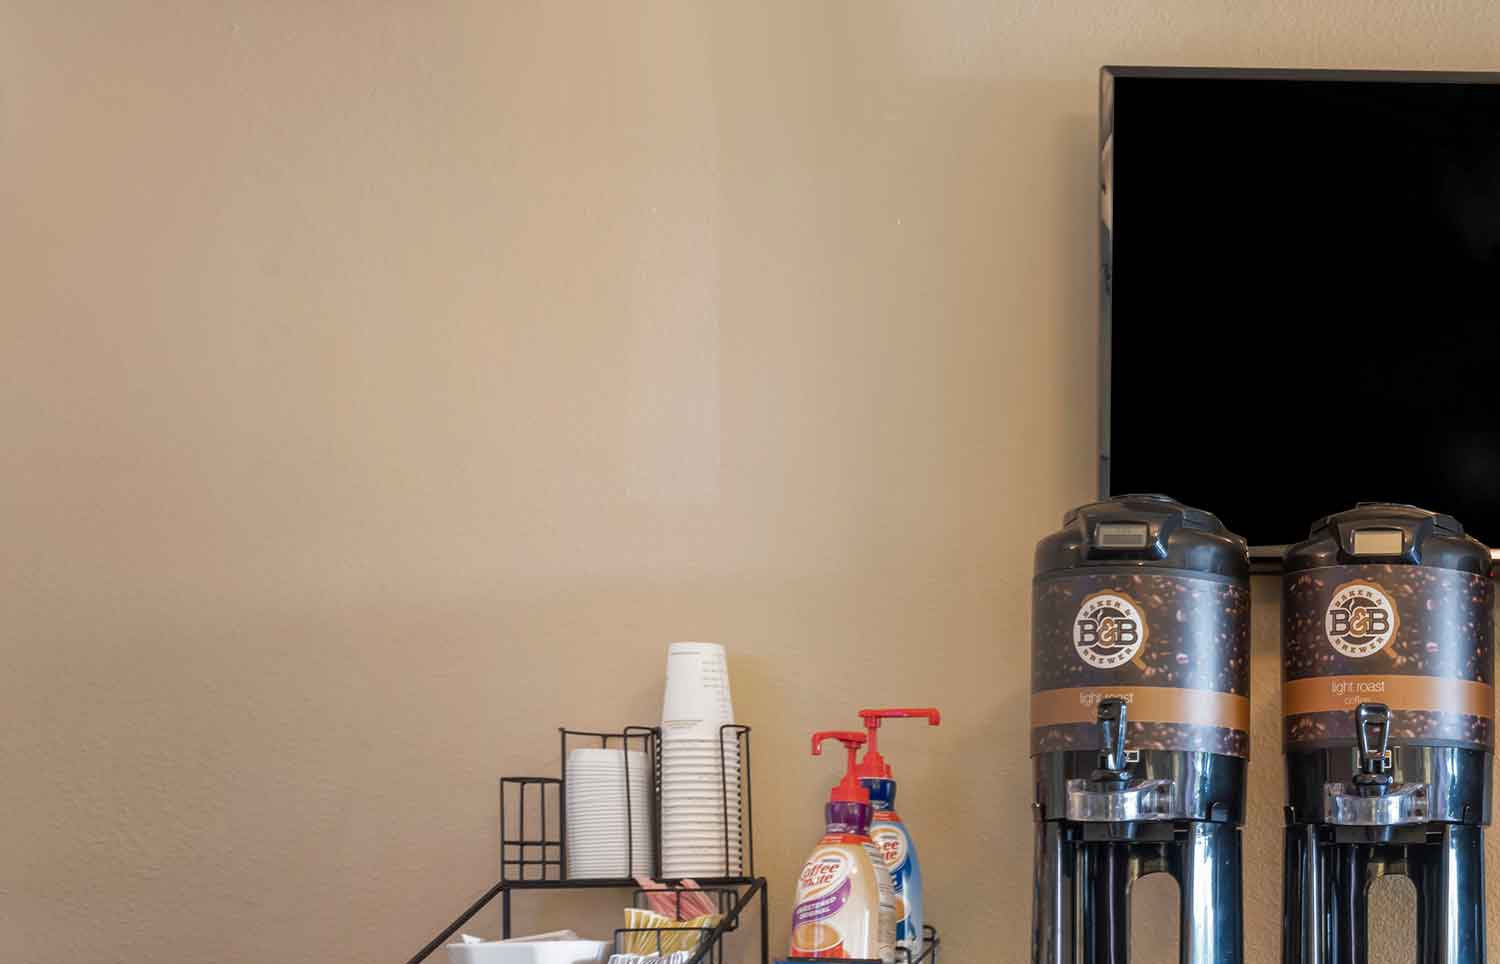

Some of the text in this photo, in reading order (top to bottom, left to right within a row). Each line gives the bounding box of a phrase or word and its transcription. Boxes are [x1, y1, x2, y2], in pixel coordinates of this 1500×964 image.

[1077, 617, 1139, 648] B&B
[1328, 607, 1390, 638] B&B
[1331, 680, 1386, 696] light roast
